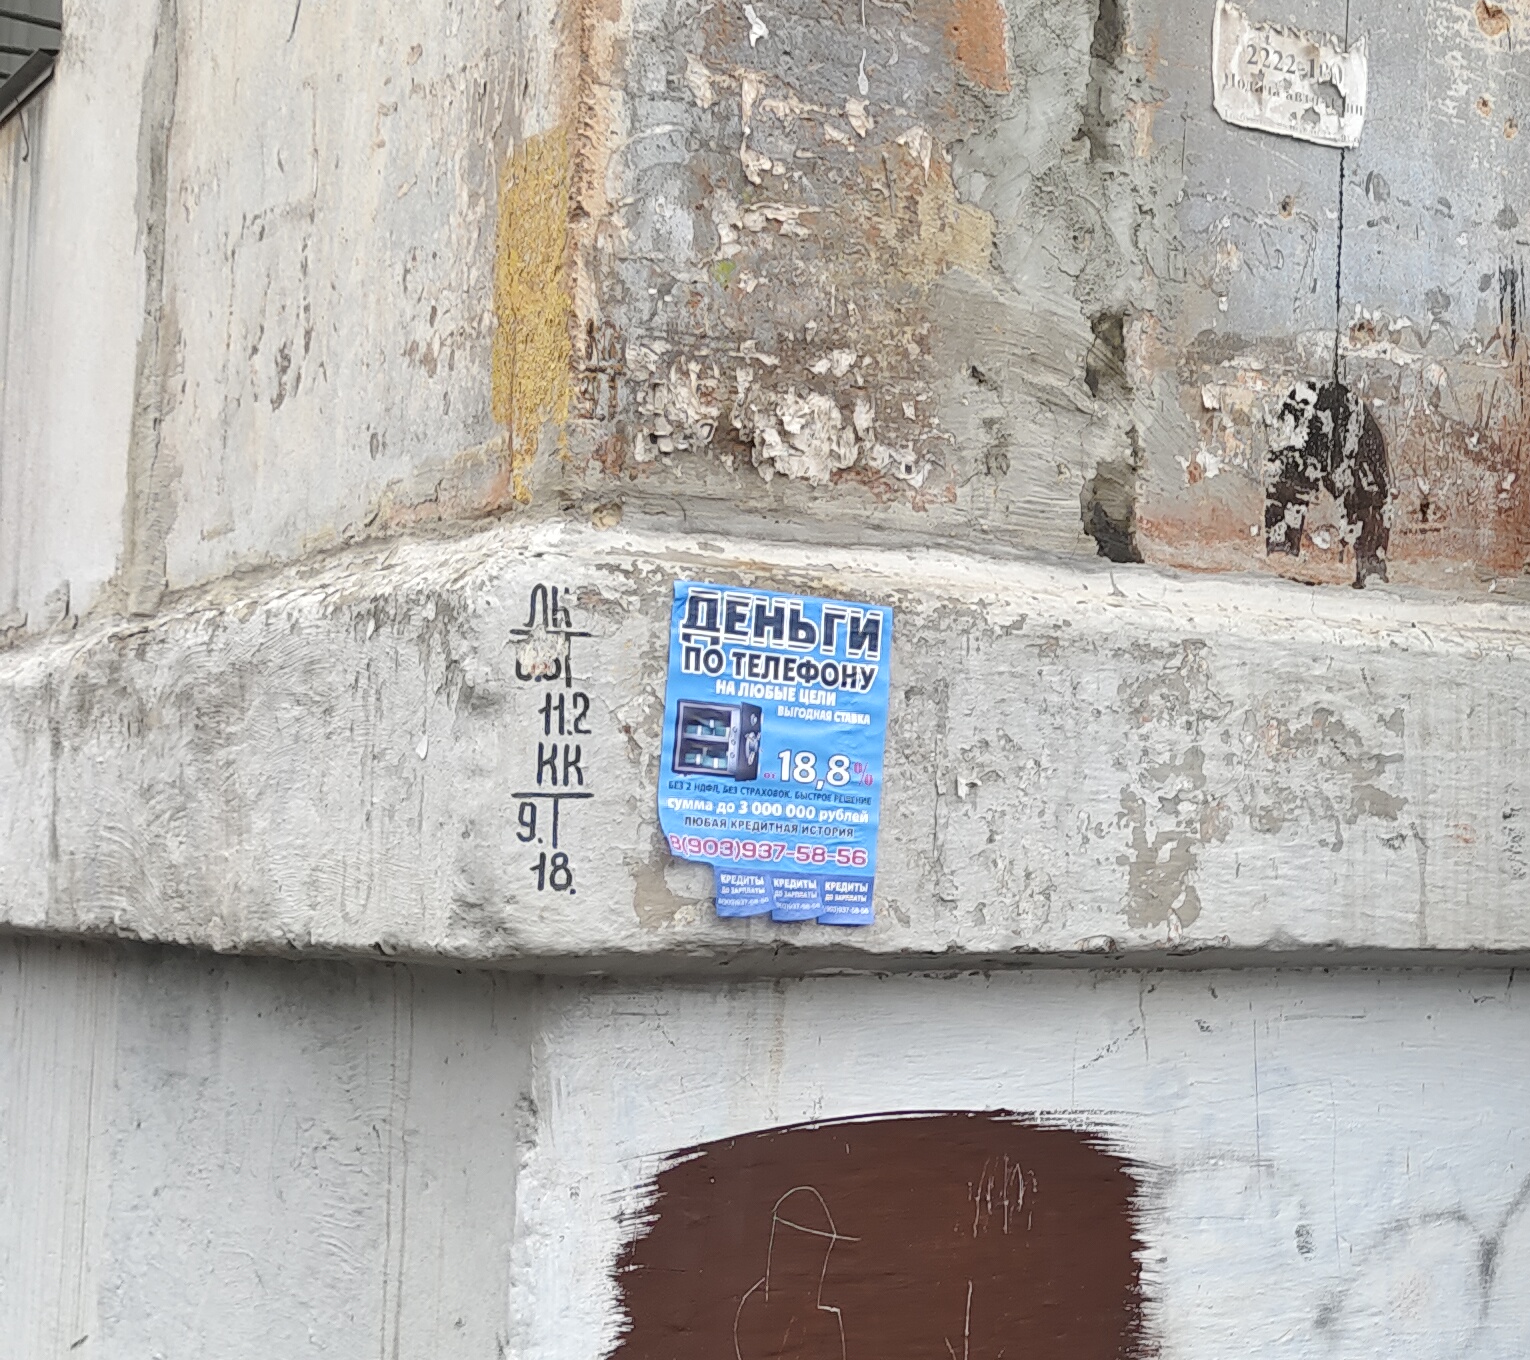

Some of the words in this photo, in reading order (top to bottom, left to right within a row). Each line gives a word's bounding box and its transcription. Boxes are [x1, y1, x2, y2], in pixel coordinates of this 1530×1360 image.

[680, 588, 882, 661] ДЕНЬГИ
[682, 643, 725, 676] ПО
[730, 649, 878, 693] ТЕЛЕФОНУ
[716, 680, 735, 696] НА
[738, 683, 796, 702] ЛЮБЫЕ
[799, 689, 836, 707] ЦЕЛИ
[538, 692, 591, 736] 11.2
[777, 706, 832, 722] ВЫГОДНАЯ
[834, 711, 870, 726] СТАВКА
[537, 742, 583, 786] КК
[668, 780, 684, 791] БЕЗ
[667, 797, 713, 811] сумма
[716, 801, 735, 815] до
[738, 800, 748, 815] 3
[751, 801, 782, 817] 000
[786, 803, 816, 819] 000
[819, 807, 869, 823] рублей
[684, 816, 727, 829] ЛЮБАЯ
[731, 819, 798, 835] КРЕДИТНАЯ
[801, 824, 854, 838] ИСТОРИЯ
[669, 834, 868, 868] 8(903)937-58-56
[720, 873, 765, 886] КРЕДИТЫ
[773, 877, 817, 890] КРЕДИТЫ
[824, 880, 869, 893] КРЕДИТЫ
